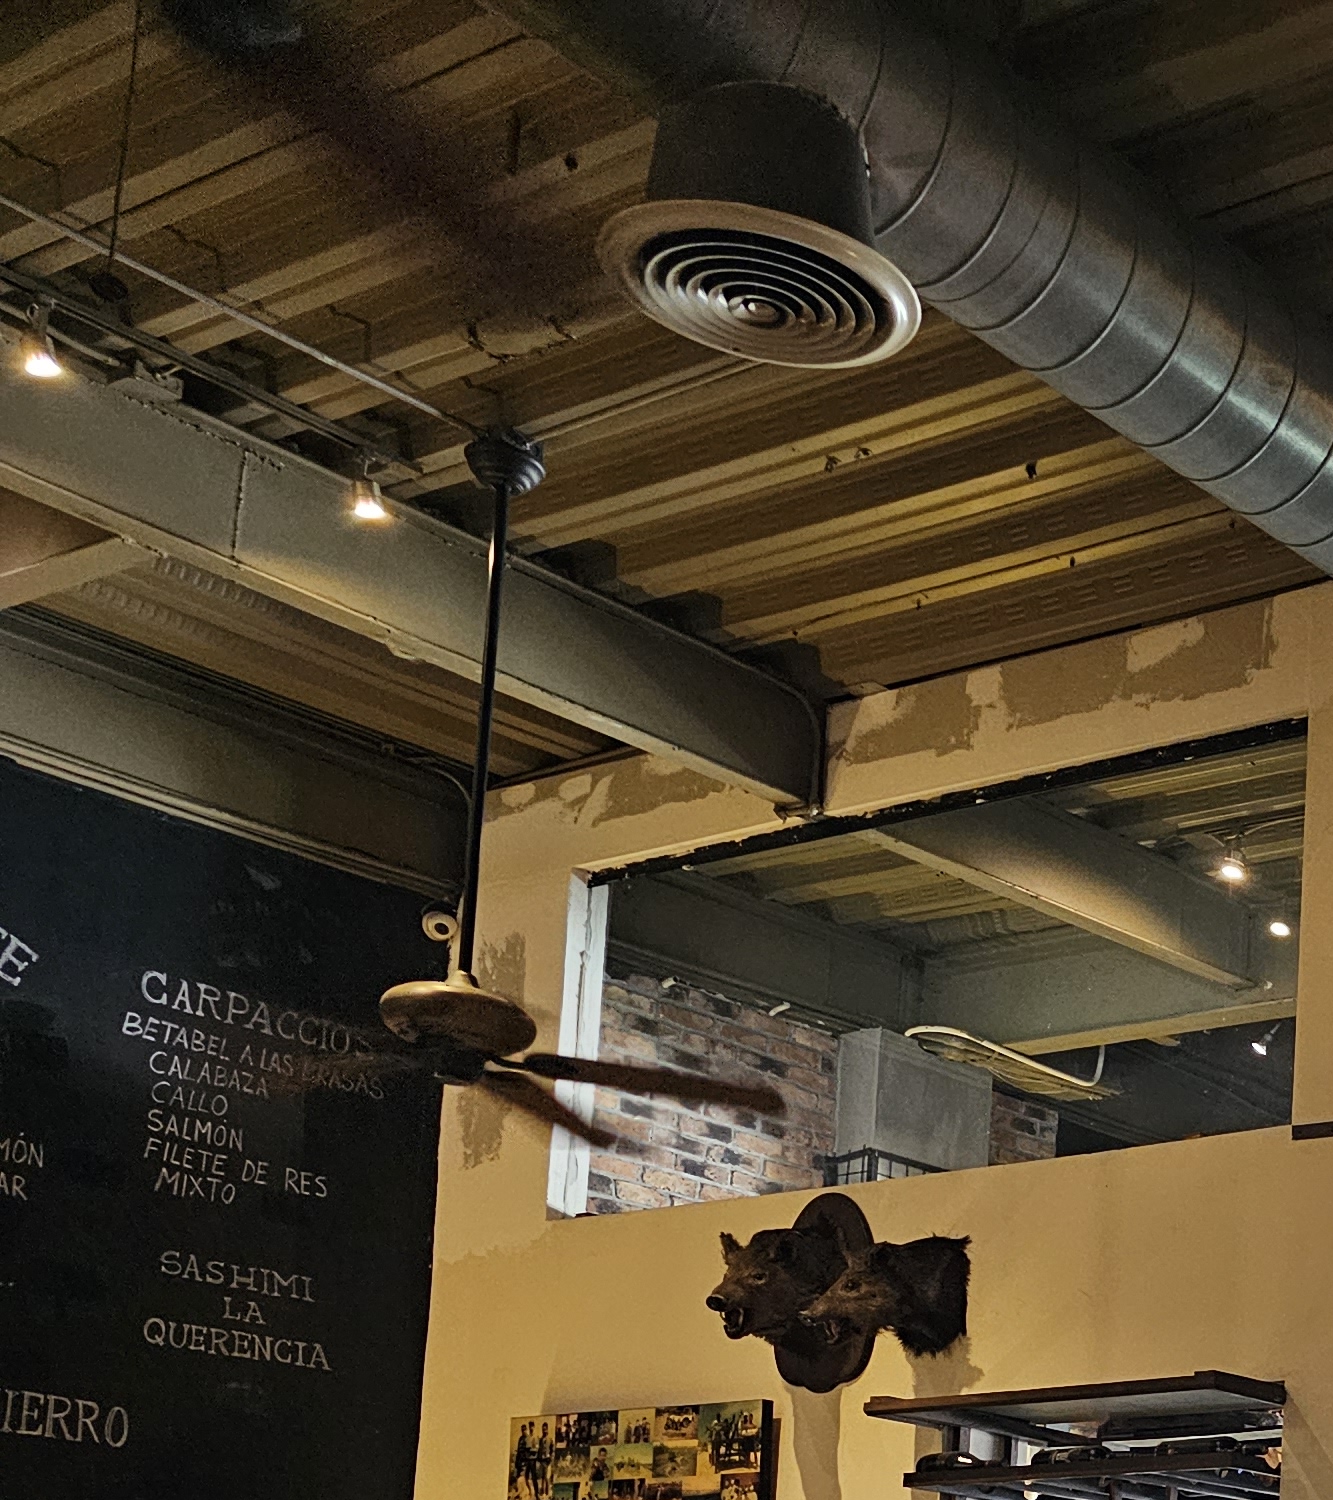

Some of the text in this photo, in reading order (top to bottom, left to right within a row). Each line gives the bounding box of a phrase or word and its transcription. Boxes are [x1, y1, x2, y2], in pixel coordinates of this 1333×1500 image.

[121, 1011, 231, 1061] BETABEL
[239, 1044, 254, 1066] A
[259, 1048, 294, 1077] LAS
[149, 1051, 270, 1099] CALABAZA
[151, 1081, 228, 1117] CALLO
[147, 1109, 243, 1152] SALMÓN
[143, 1137, 328, 1198] FILETE DE RES
[154, 1167, 236, 1204] MIXTO
[160, 1250, 316, 1302] SASHIMI
[223, 1297, 266, 1325] LA
[143, 1317, 333, 1372] QUERENCIA
